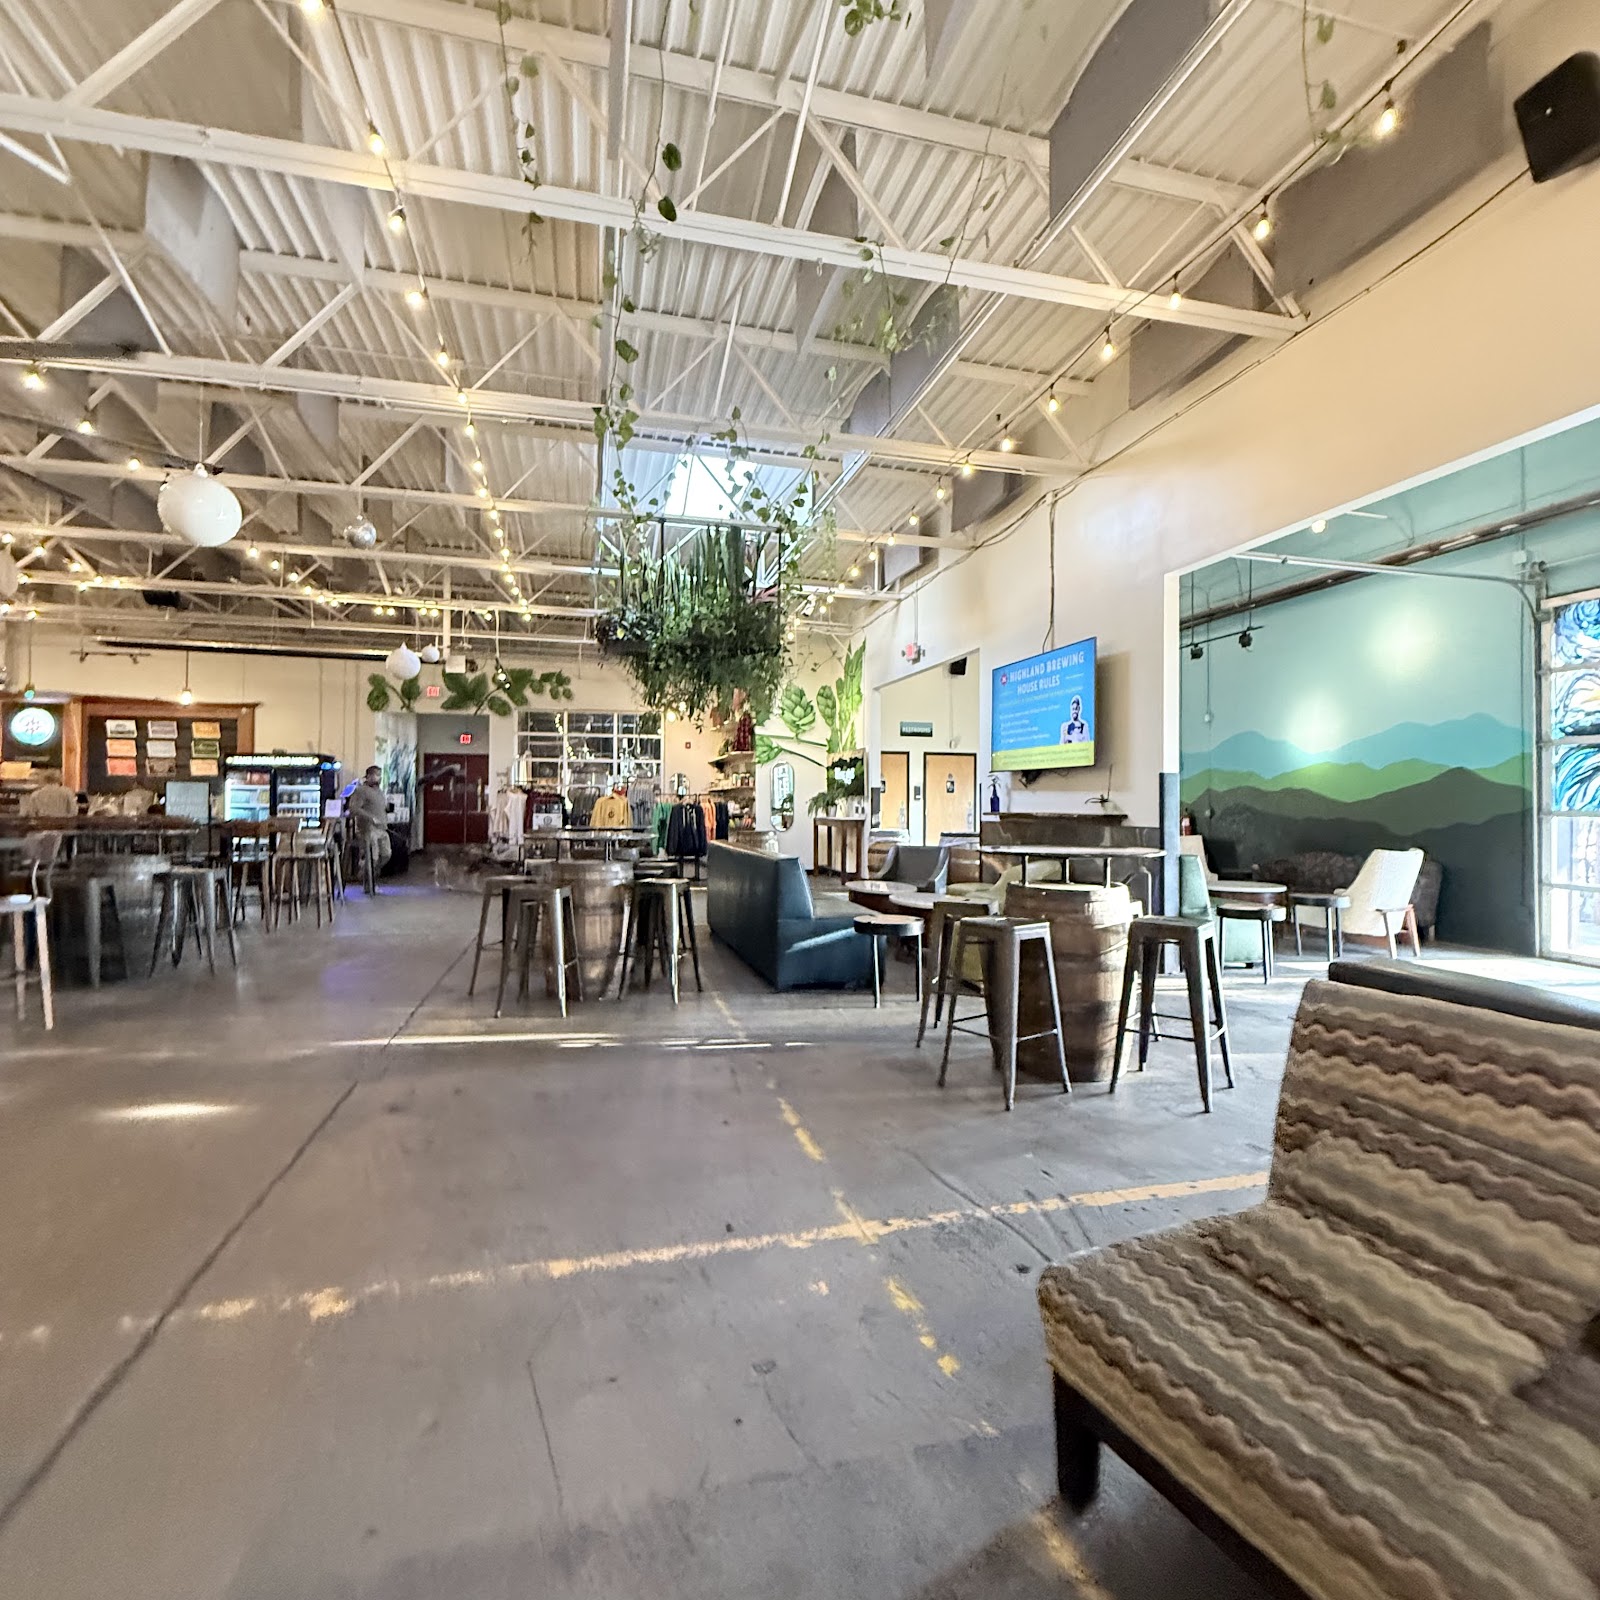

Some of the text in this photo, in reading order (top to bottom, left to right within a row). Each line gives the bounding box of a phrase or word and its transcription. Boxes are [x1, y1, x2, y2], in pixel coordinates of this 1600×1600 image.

[1009, 651, 1084, 682] HIGHLAND BREWING
[1017, 674, 1061, 694] HOUSE RULES
[902, 726, 931, 734] RESTROOMS
